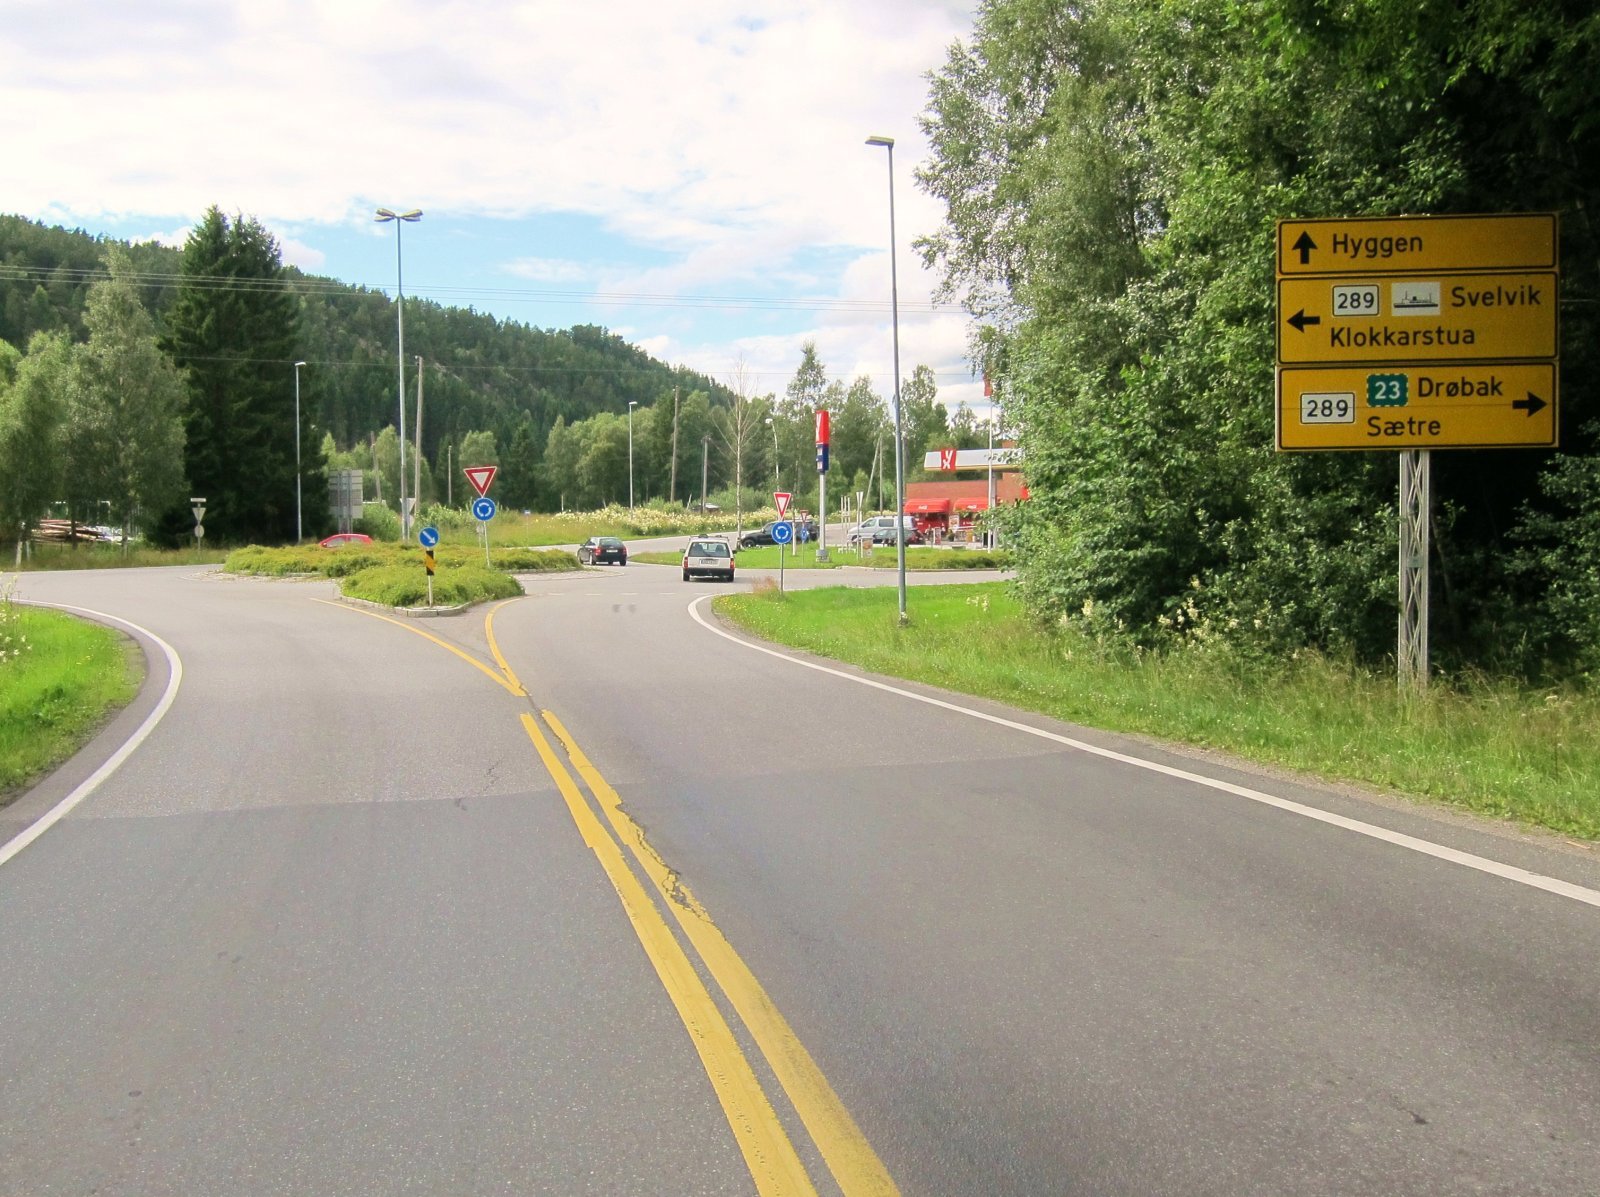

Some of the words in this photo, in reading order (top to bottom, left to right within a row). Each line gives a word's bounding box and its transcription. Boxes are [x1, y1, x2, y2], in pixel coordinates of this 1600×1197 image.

[1332, 233, 1423, 259] Hyggen
[1337, 292, 1375, 309] 289
[1451, 286, 1541, 307] Svelvik
[1331, 327, 1475, 348] Klokkarstua
[1374, 381, 1401, 400] 23
[1418, 376, 1503, 397] Drøbak
[1306, 400, 1349, 418] 289
[1367, 417, 1441, 437] Sætre
